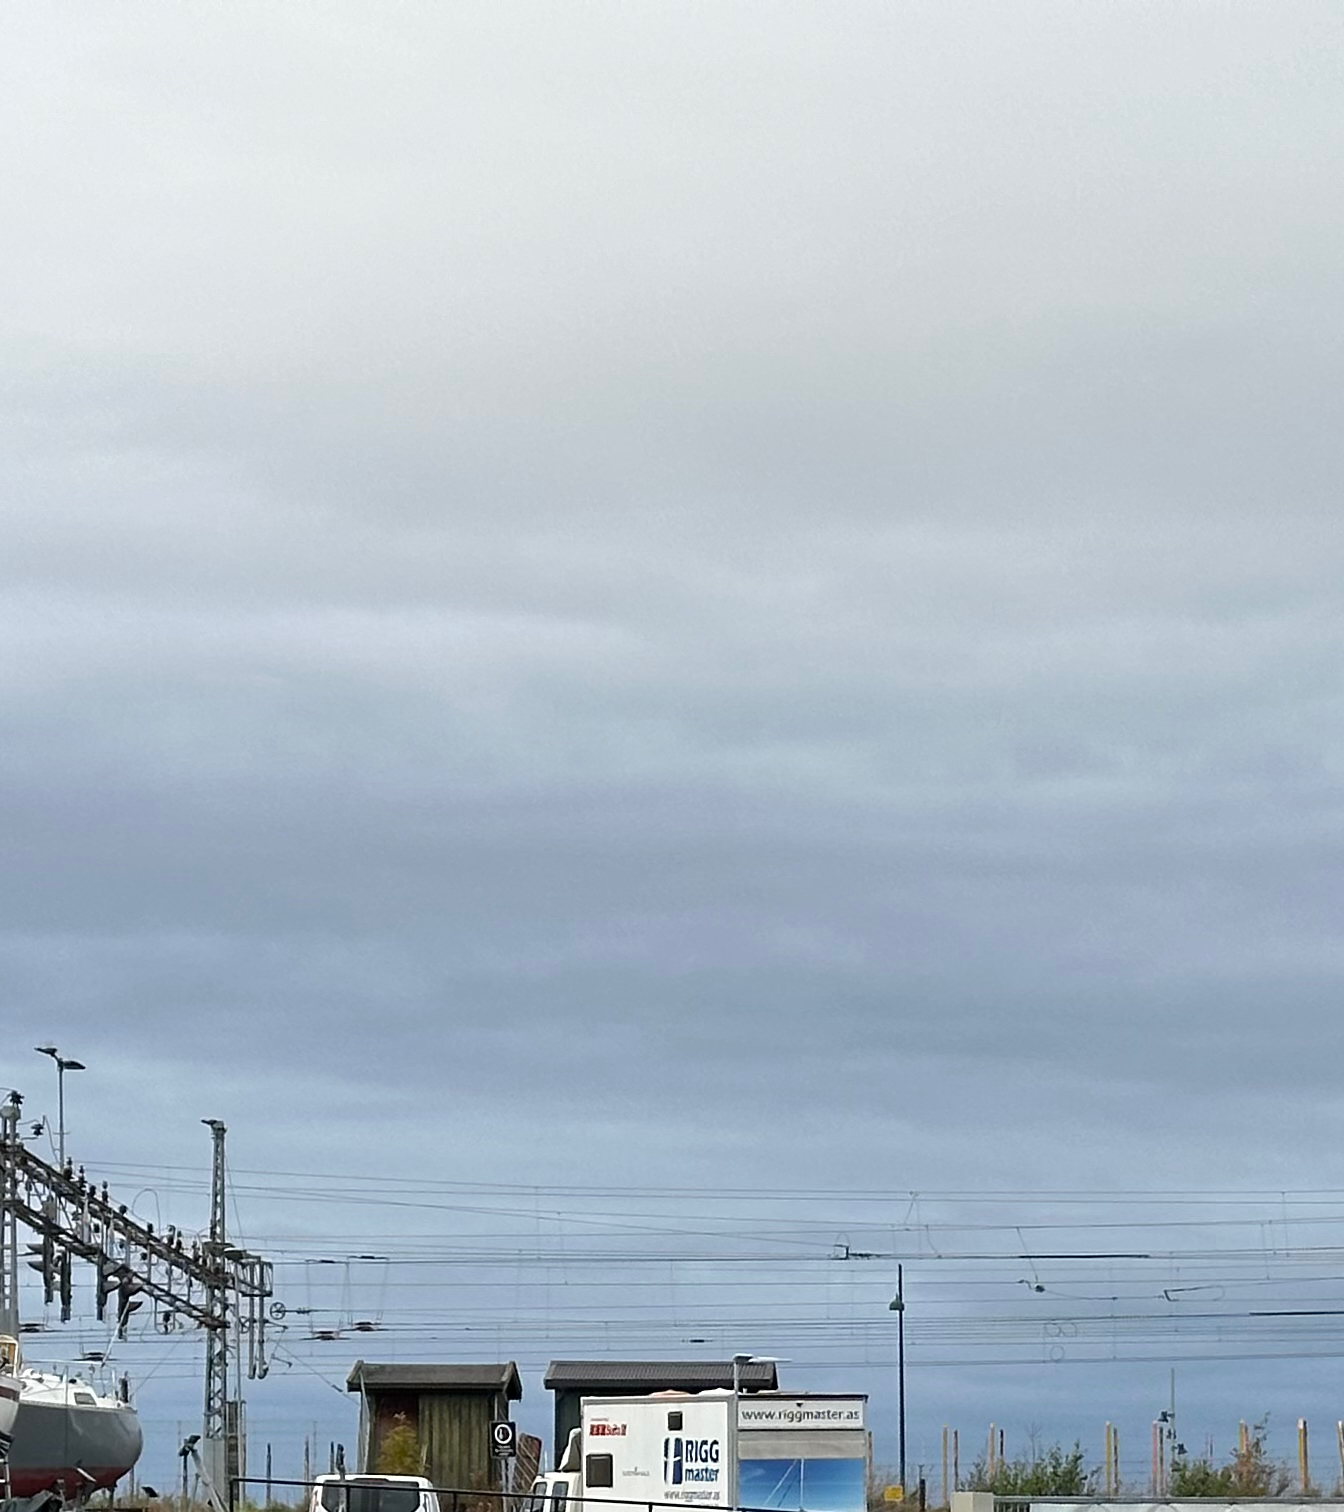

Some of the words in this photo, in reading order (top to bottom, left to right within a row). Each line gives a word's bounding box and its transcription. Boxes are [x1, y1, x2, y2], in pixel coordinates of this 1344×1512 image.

[741, 1409, 860, 1423] www.riggmaster.as
[685, 1439, 719, 1463] RIGG
[685, 1466, 720, 1482] master
